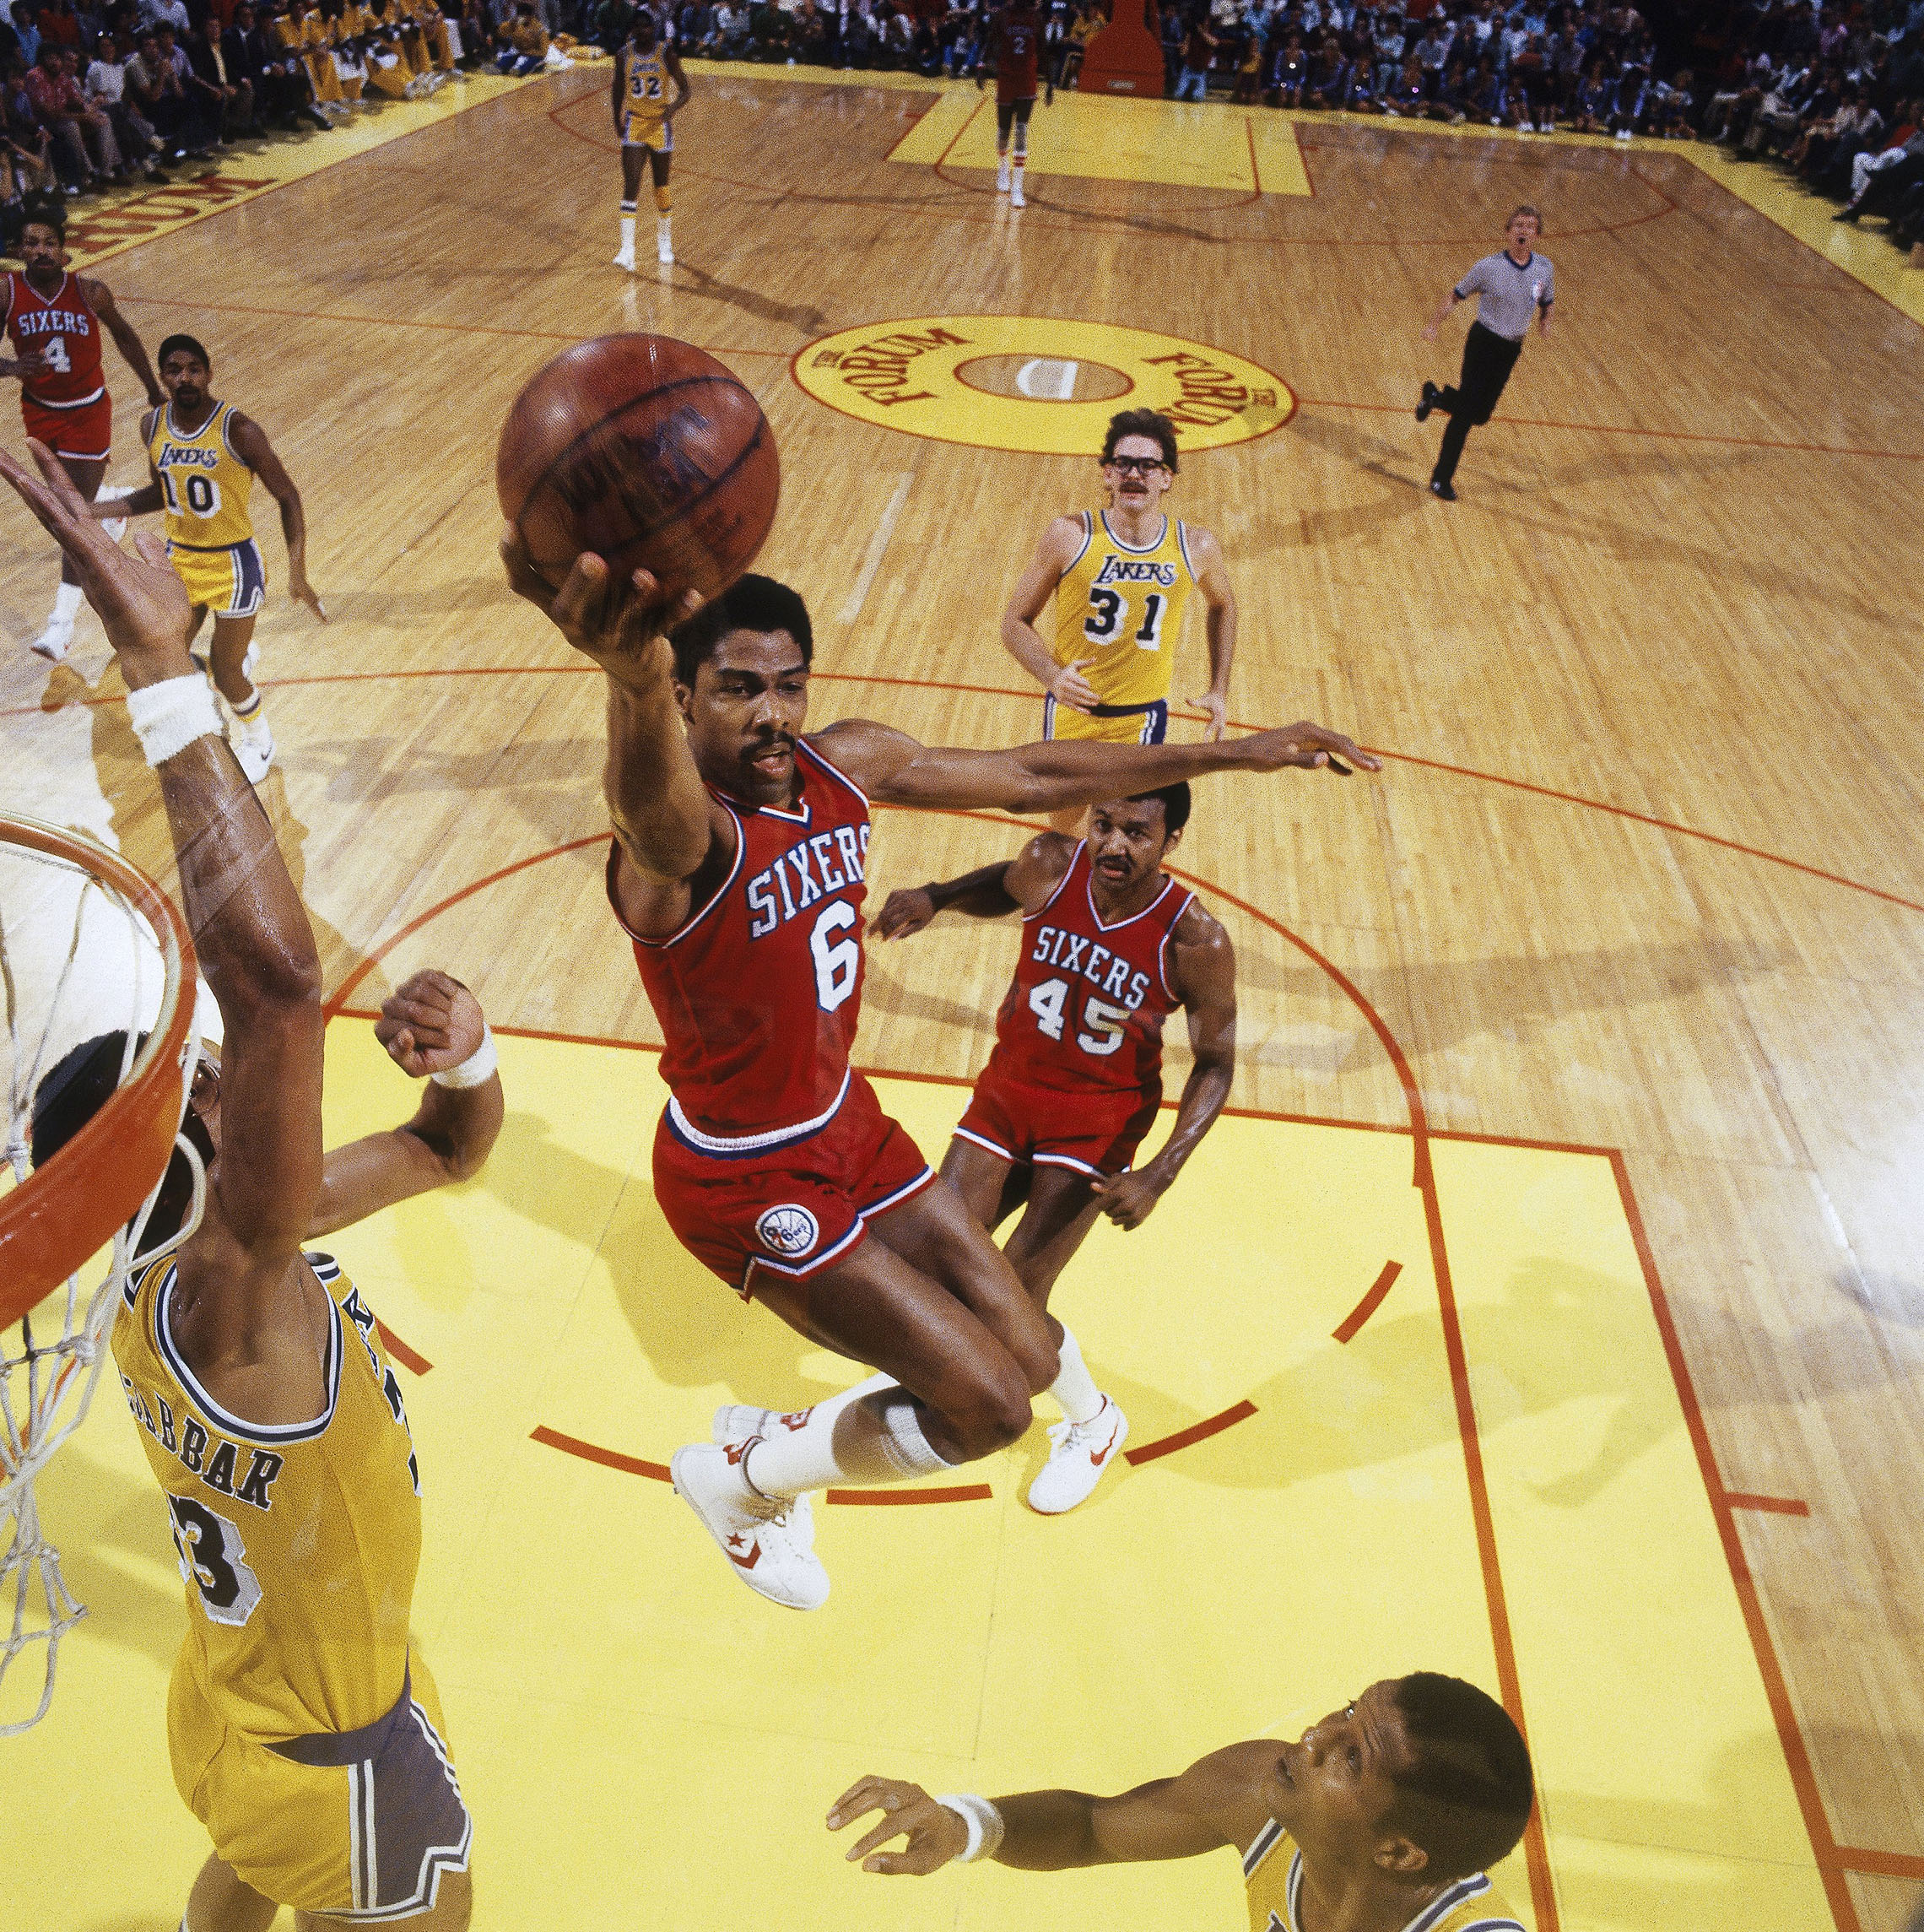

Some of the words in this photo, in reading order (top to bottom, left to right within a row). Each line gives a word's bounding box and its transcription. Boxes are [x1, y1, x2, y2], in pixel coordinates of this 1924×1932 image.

[1013, 36, 1025, 54] 2
[630, 76, 662, 99] 32
[17, 309, 90, 338] SIXERS
[43, 335, 71, 373] 4
[839, 327, 974, 406] FORUM
[158, 441, 219, 470] LAKERS
[159, 469, 222, 519] 10
[1092, 554, 1178, 587] LAKERS
[1084, 587, 1168, 652] 31
[808, 896, 860, 1015] 6
[1031, 924, 1151, 1011] SIXERS
[1029, 977, 1132, 1057] 45
